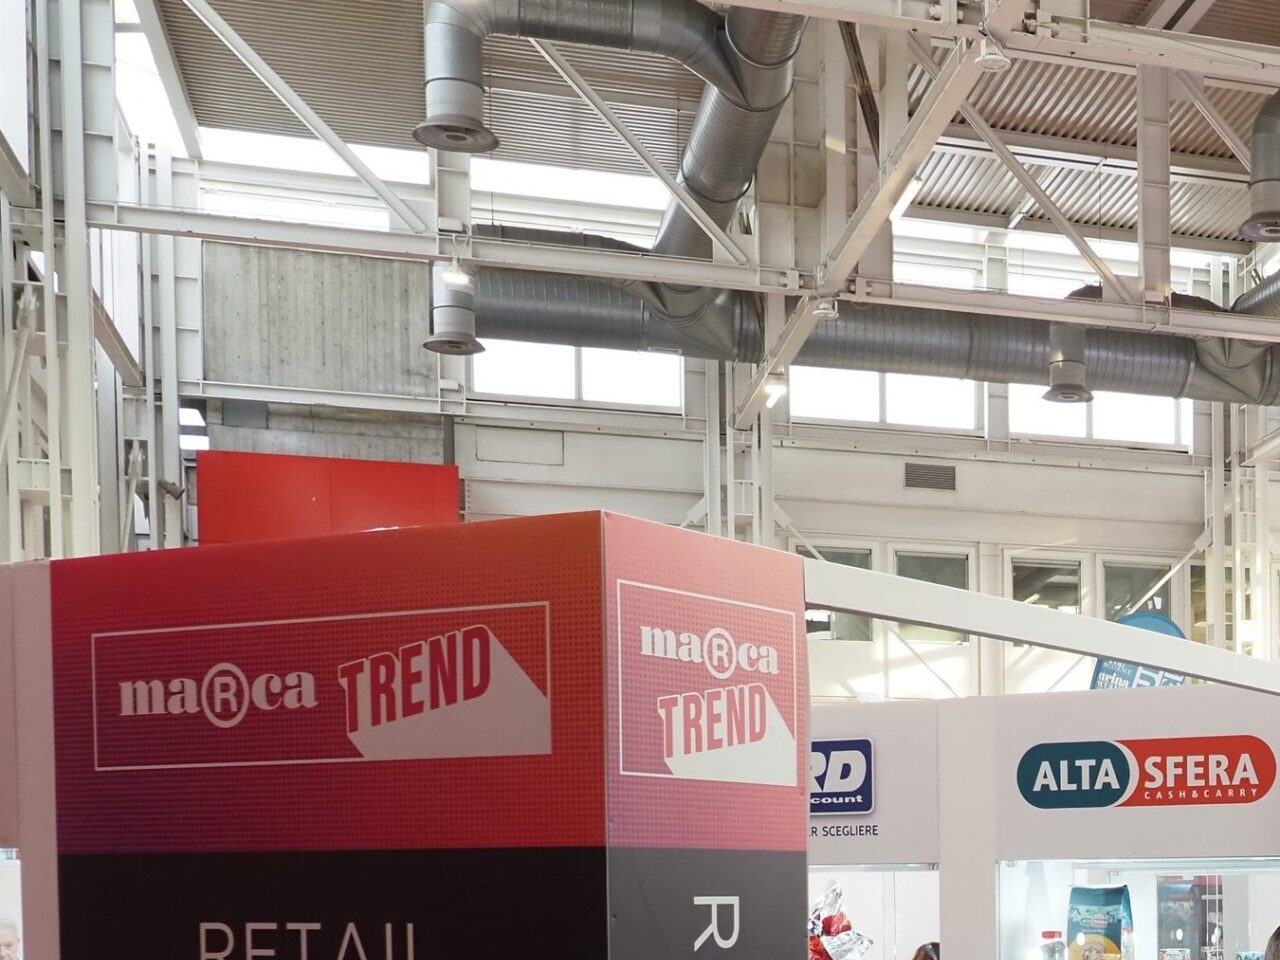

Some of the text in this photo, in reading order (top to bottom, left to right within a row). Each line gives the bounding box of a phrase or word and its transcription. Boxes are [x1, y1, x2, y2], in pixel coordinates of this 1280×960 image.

[339, 625, 491, 734] TREND
[657, 683, 767, 758] TREND
[1033, 754, 1259, 791] ALTA SFERA
[822, 825, 878, 836] SCEGLIERE
